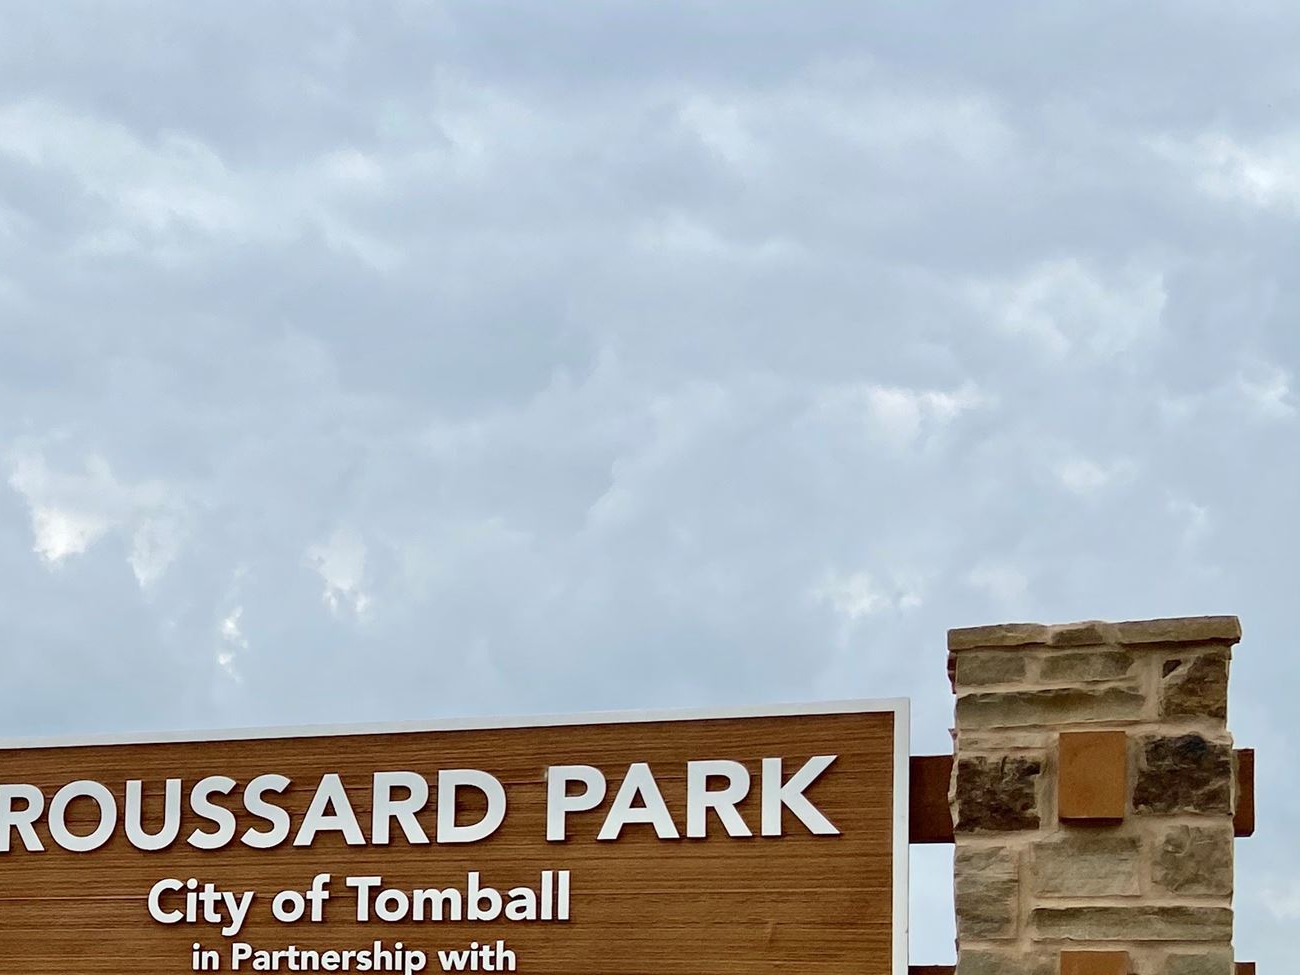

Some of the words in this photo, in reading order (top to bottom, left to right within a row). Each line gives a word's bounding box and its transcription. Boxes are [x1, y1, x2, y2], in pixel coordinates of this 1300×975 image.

[546, 754, 841, 841] PARK
[148, 878, 255, 937] City
[272, 873, 331, 922] of
[346, 870, 570, 922] Tomball
[192, 942, 220, 970] in
[437, 940, 516, 971] with
